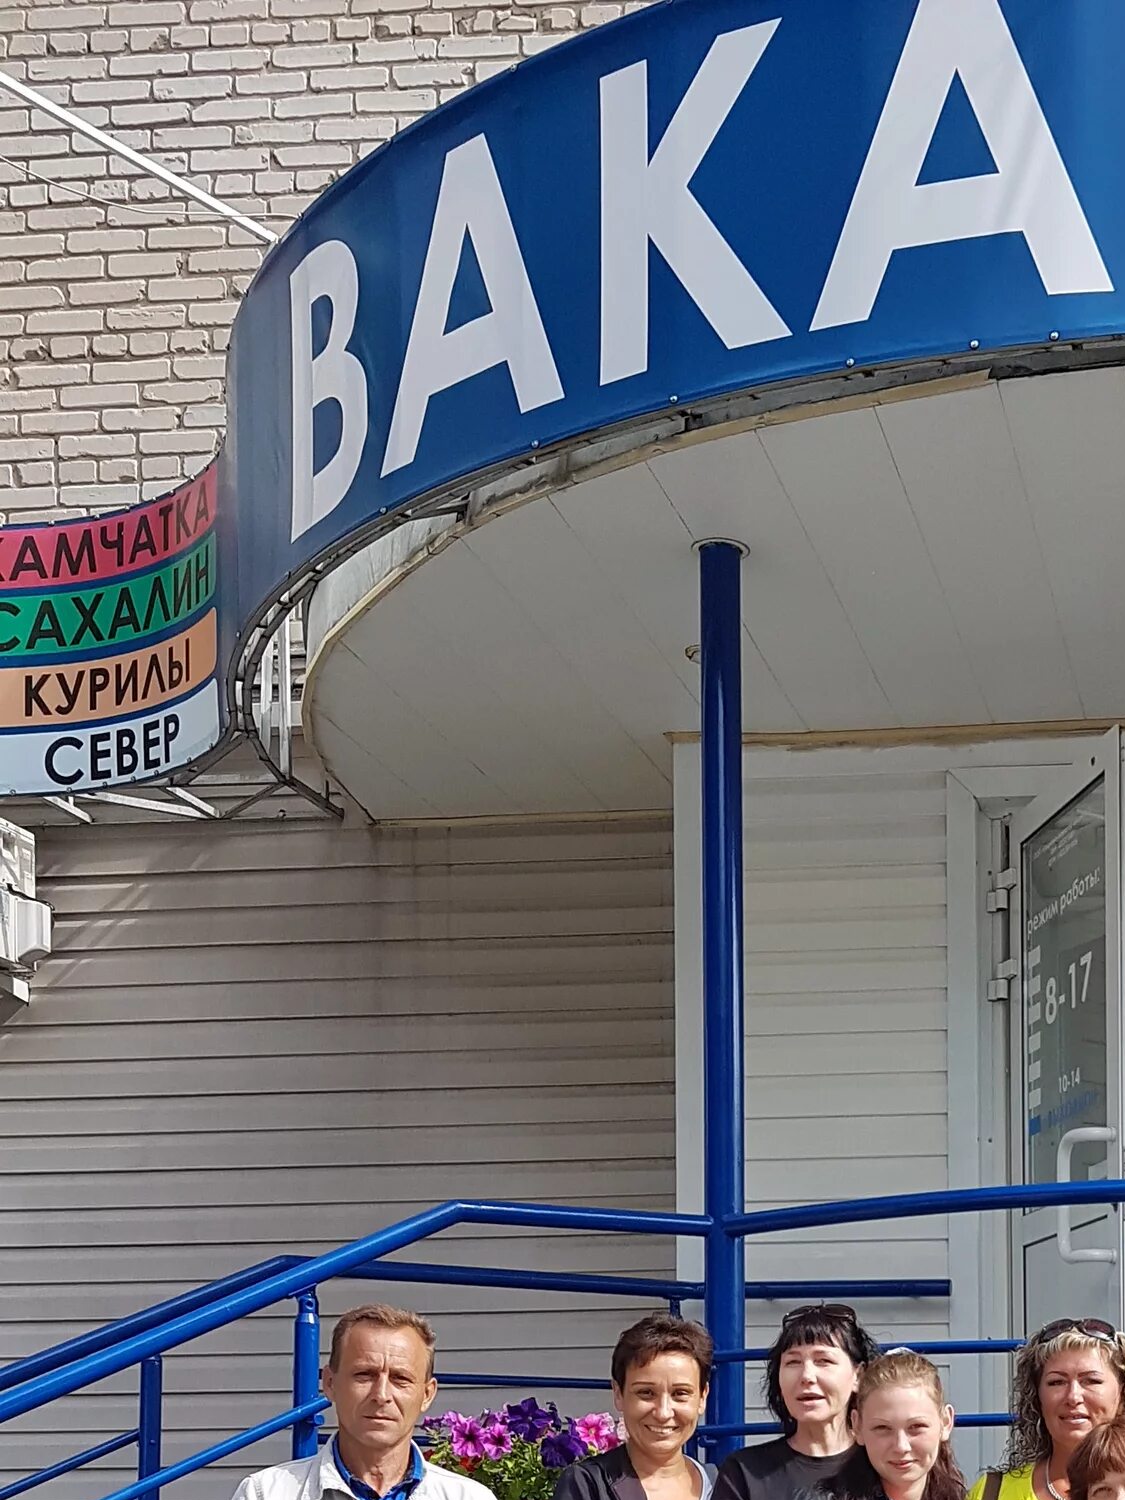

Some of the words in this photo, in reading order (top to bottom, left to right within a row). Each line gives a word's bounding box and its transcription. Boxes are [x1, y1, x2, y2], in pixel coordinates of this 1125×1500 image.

[0, 486, 209, 582] АМЧАТКА
[24, 638, 190, 717] КУРИЛЫ
[45, 713, 180, 786] СЕВЕР
[1027, 900, 1059, 941] режим
[1045, 951, 1092, 1024] 8-17
[1058, 1067, 1081, 1094] 10-14
